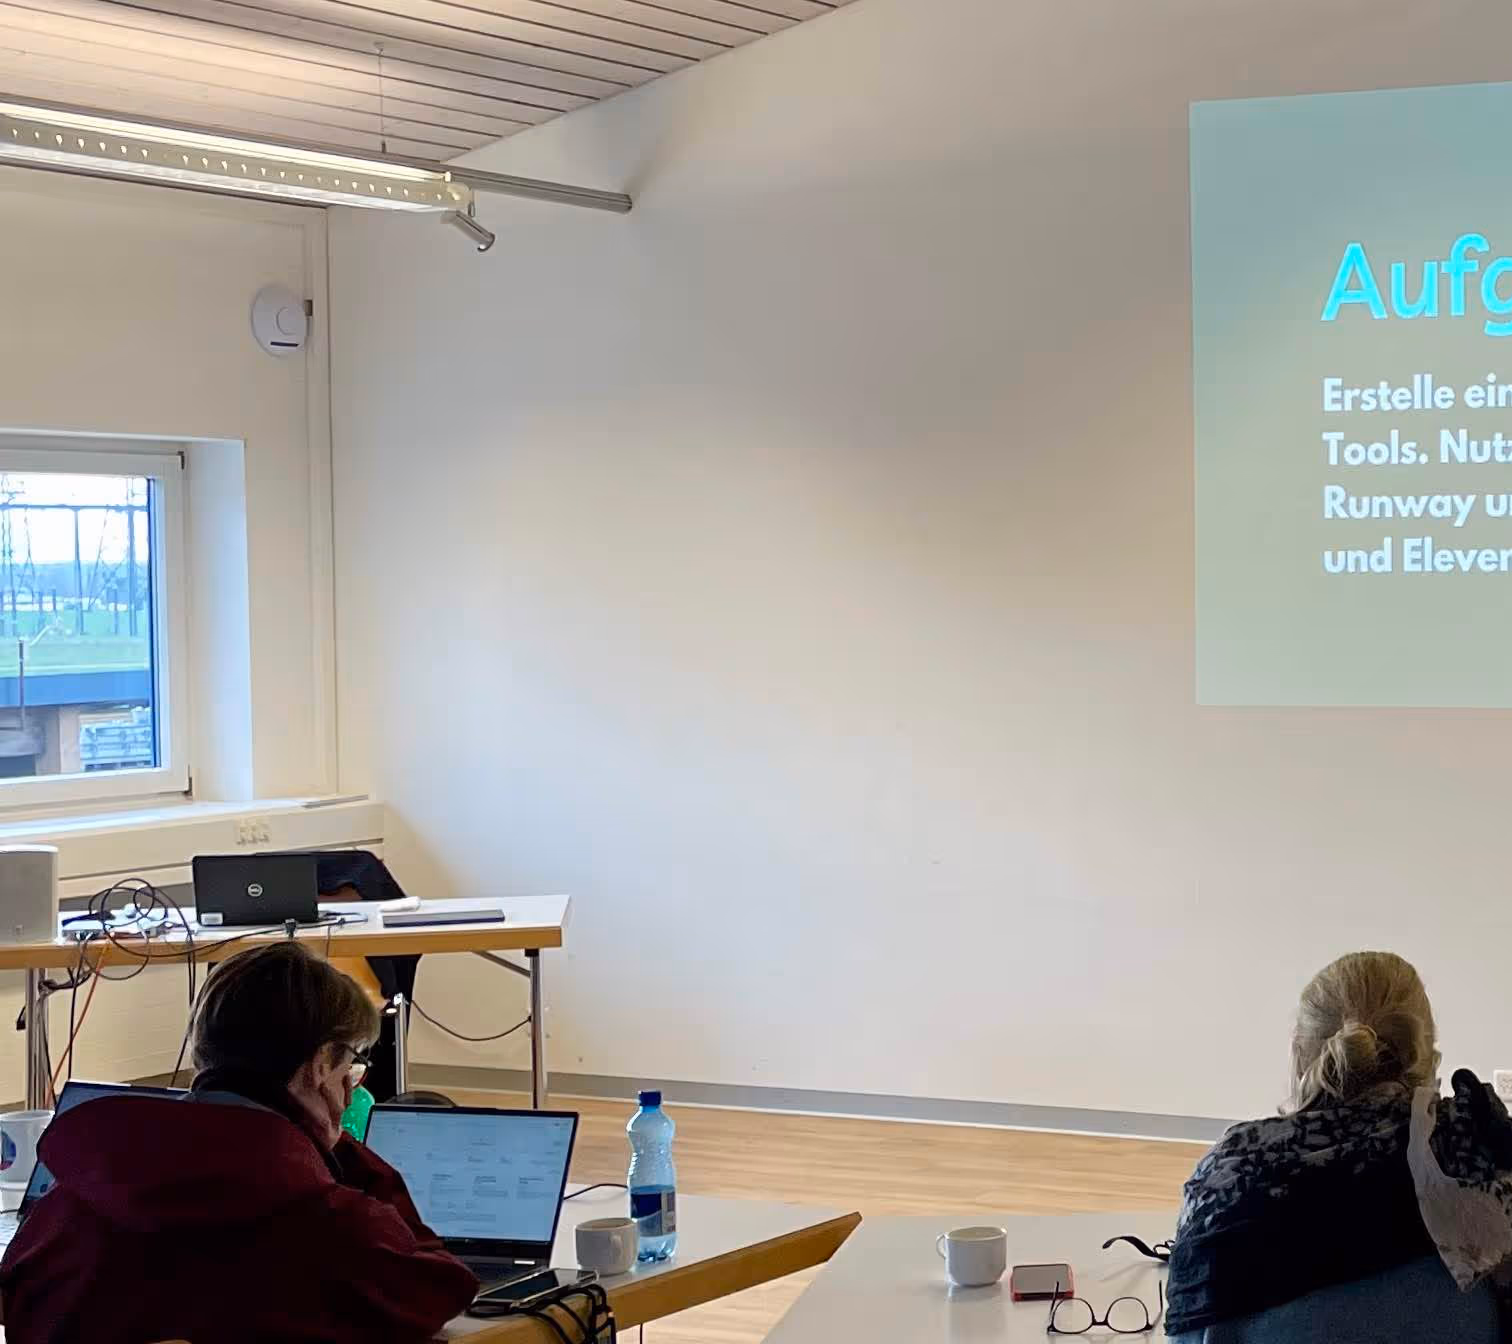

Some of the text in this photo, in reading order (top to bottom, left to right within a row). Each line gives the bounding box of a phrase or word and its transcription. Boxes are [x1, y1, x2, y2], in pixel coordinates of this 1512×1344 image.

[1322, 373, 1455, 411] Erstelle
[1322, 429, 1429, 466] Tools.
[1323, 485, 1476, 528] Runway
[1322, 537, 1393, 574] und
